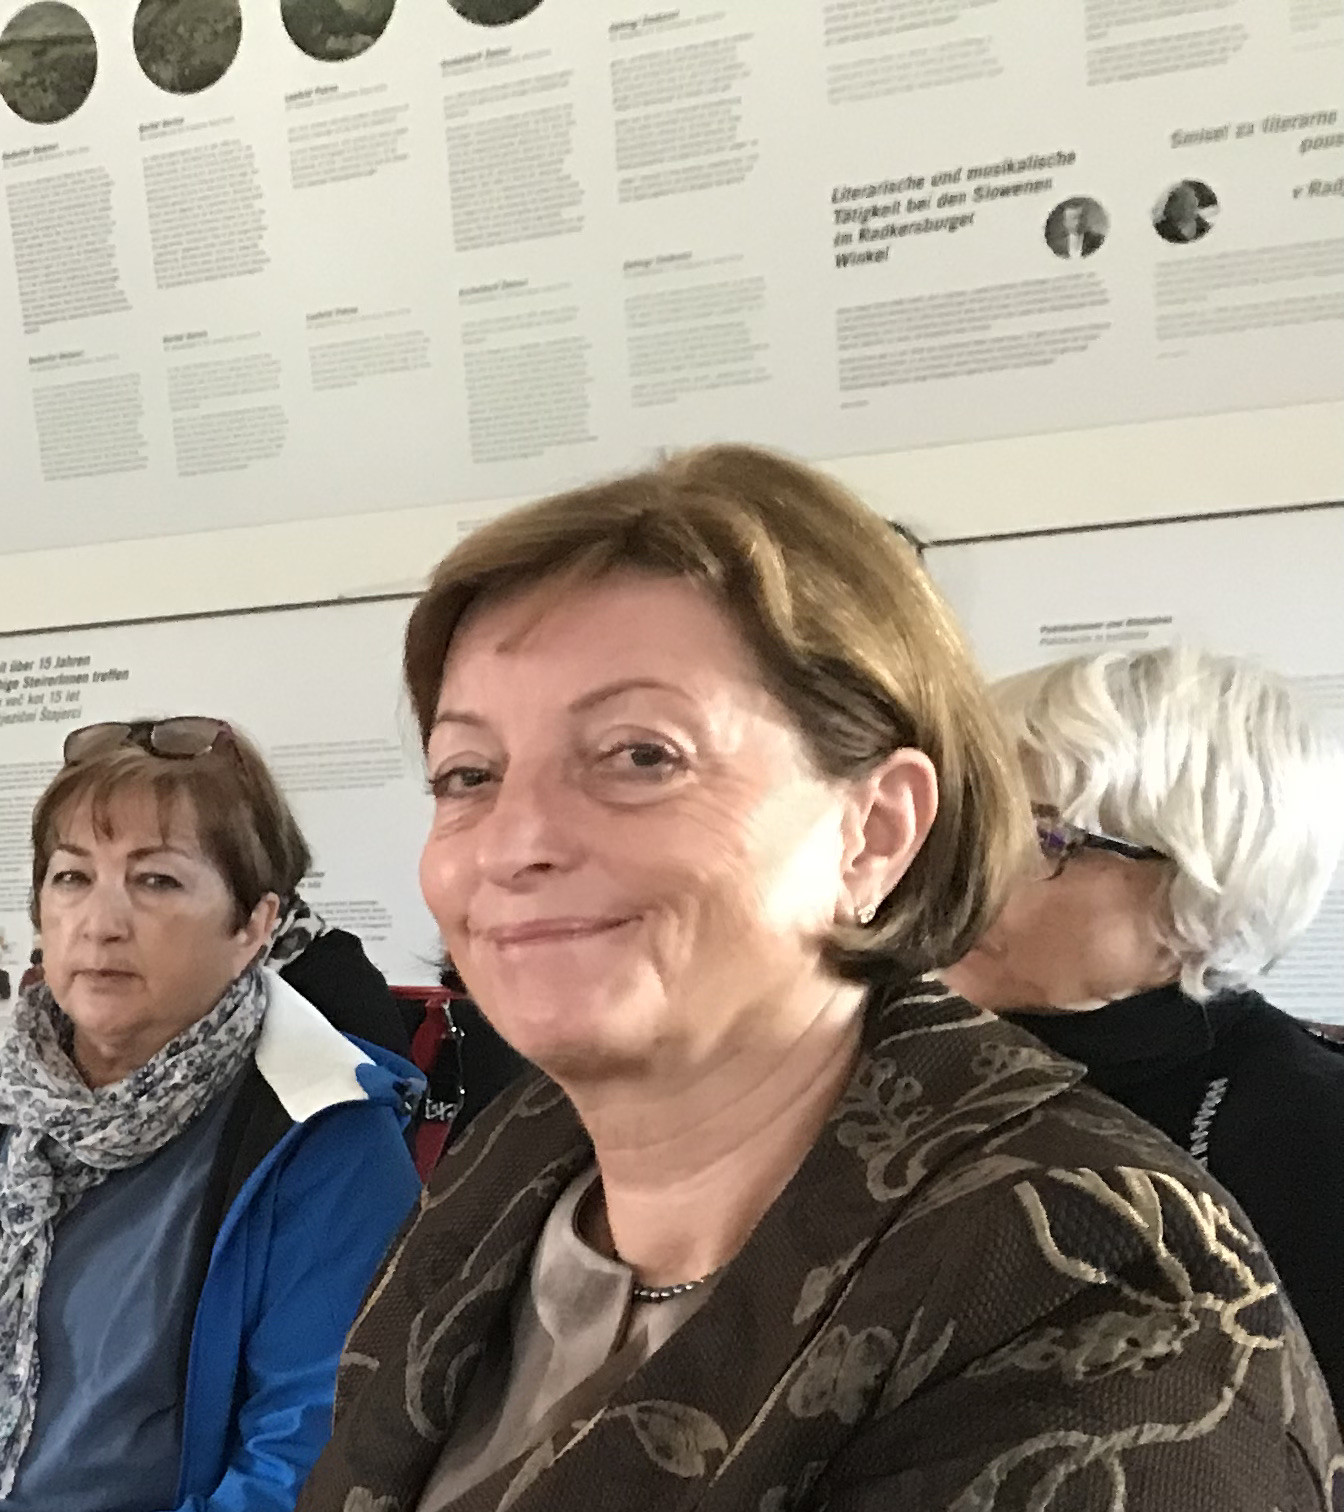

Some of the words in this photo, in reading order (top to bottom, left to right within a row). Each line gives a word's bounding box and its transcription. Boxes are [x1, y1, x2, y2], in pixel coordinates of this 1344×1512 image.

[831, 175, 925, 204] Literarische
[930, 167, 962, 187] und
[967, 150, 1076, 180] musikalische
